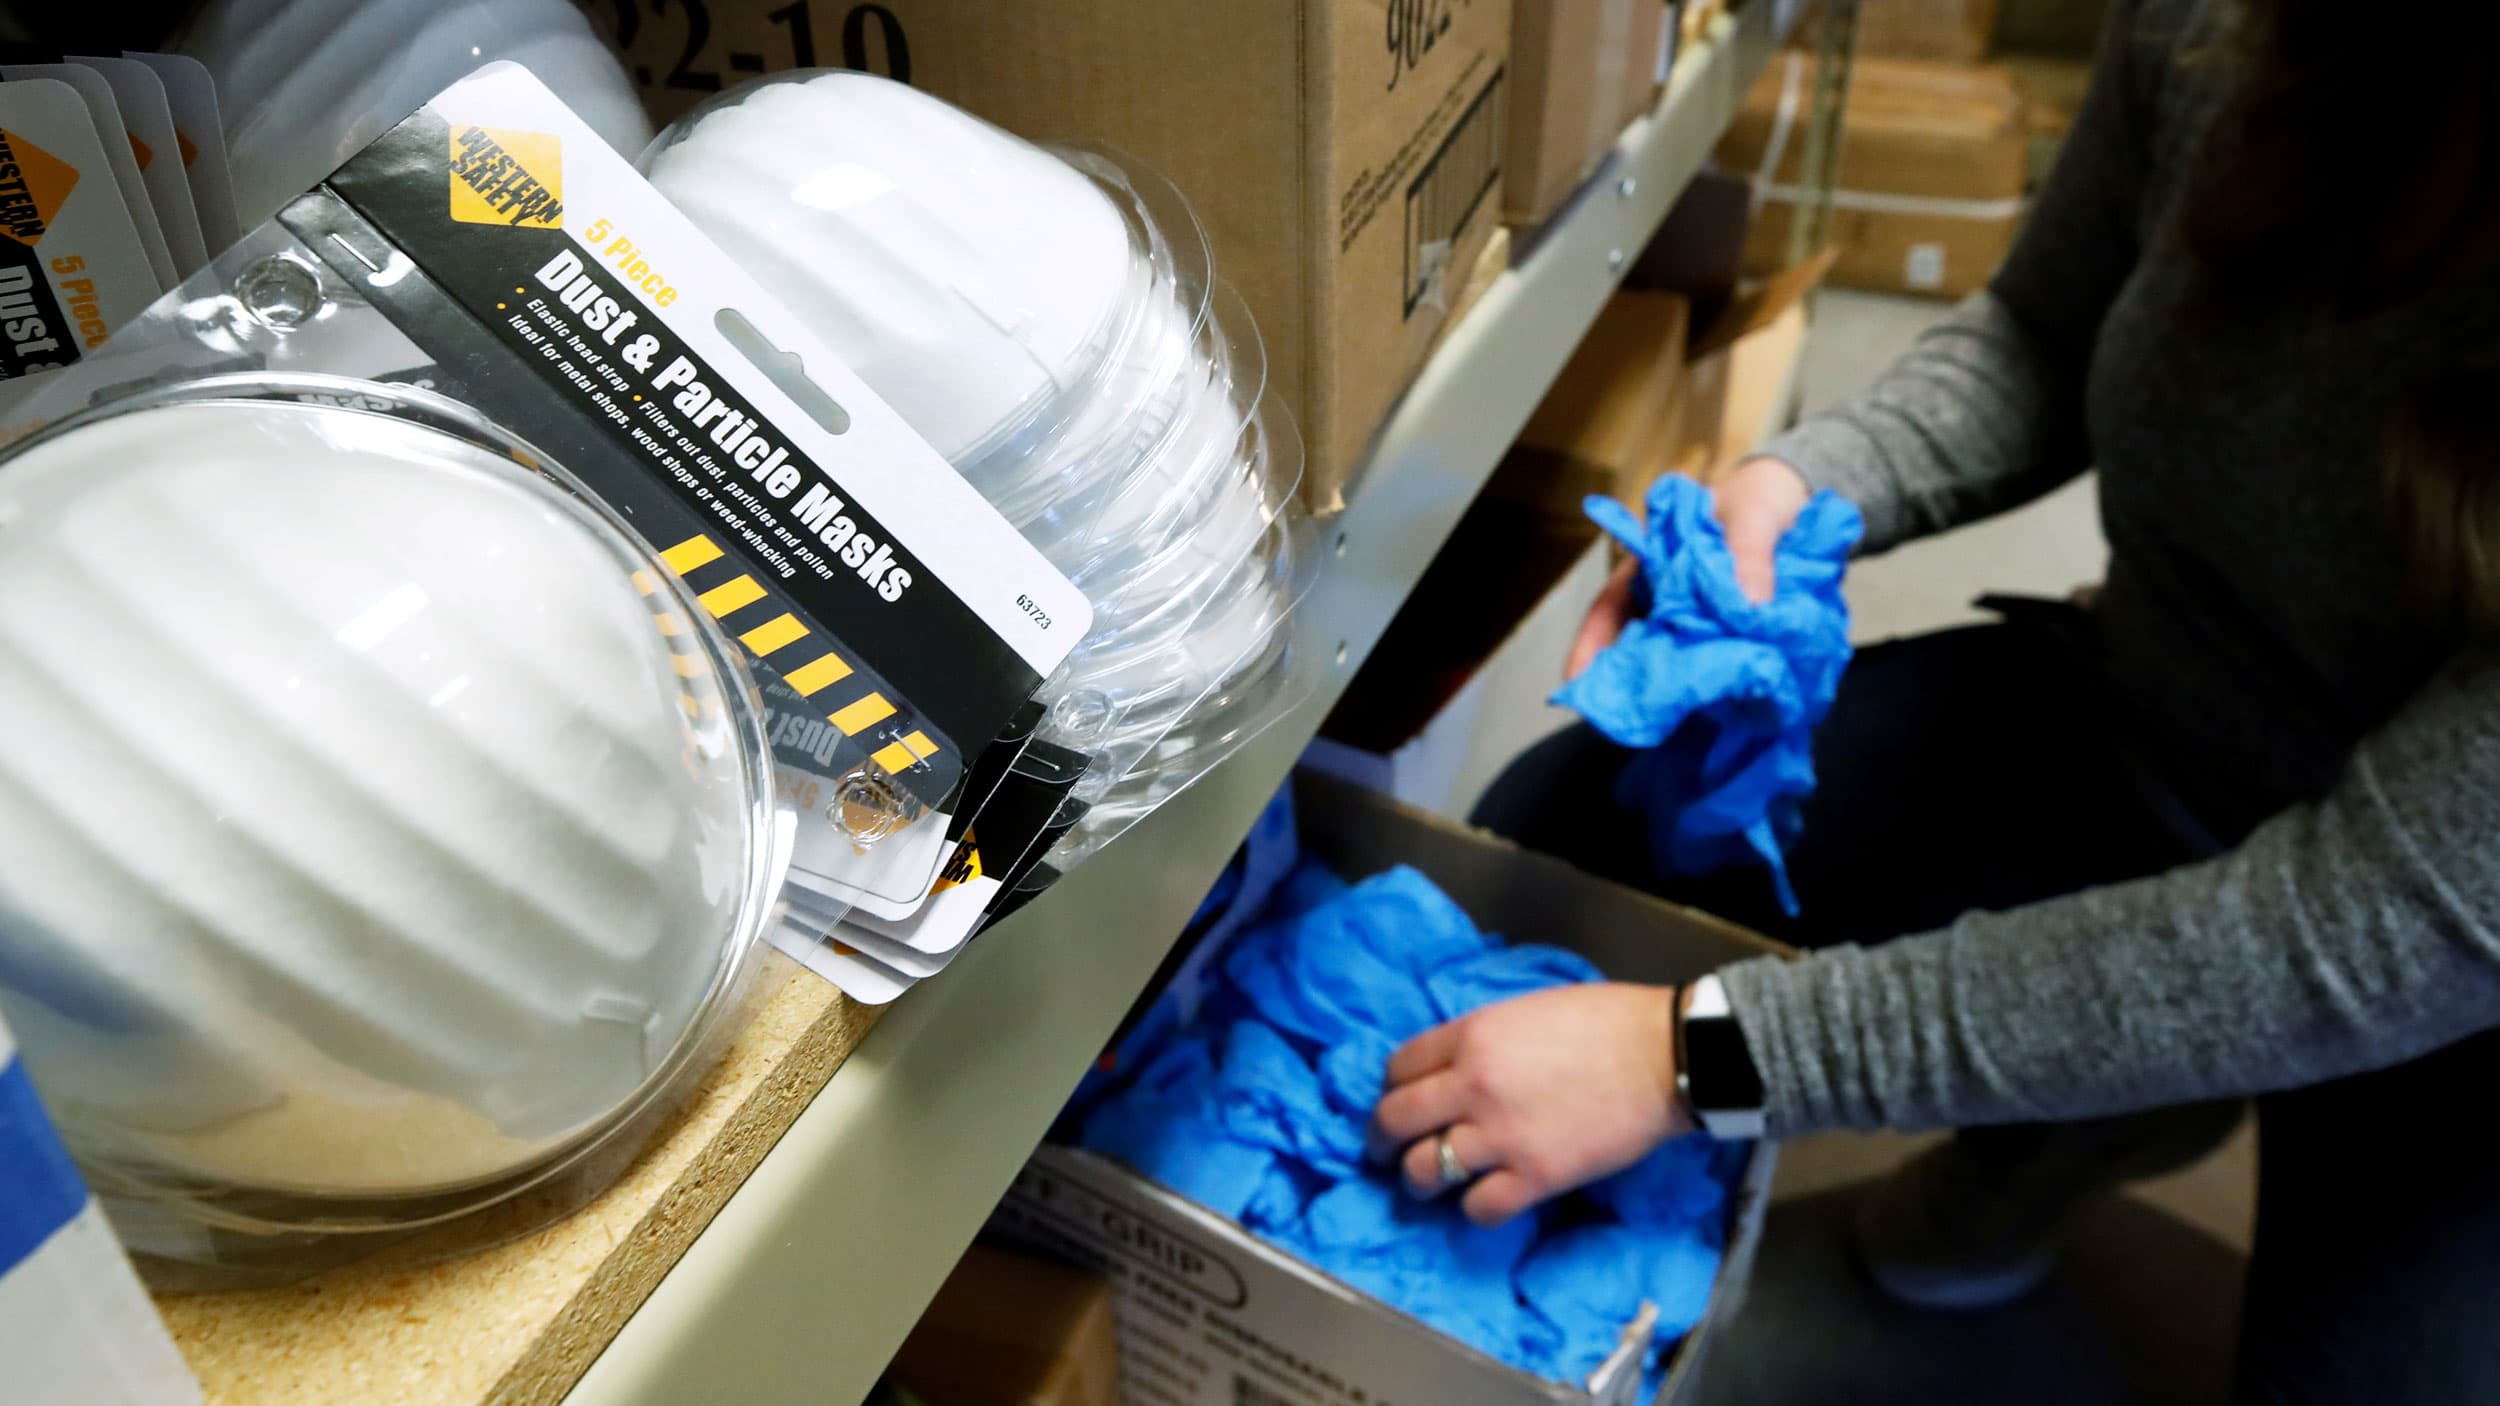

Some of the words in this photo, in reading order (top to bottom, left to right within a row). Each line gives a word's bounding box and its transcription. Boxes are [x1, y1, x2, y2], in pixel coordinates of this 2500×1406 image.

[450, 151, 542, 226] SAFETY
[457, 126, 563, 224] WESTERN
[51, 255, 86, 274] 5
[584, 218, 614, 244] 5
[603, 236, 678, 307] Piece
[508, 314, 546, 344] Ideal
[539, 343, 563, 361] for
[557, 361, 599, 393] metal
[591, 392, 630, 429] shops,
[631, 427, 668, 457] wood
[662, 456, 700, 489] shops
[696, 487, 714, 501] or
[710, 499, 797, 578] weed-whacking
[526, 299, 571, 337] Elastic
[566, 335, 603, 364] head
[596, 363, 630, 392] strap
[639, 401, 680, 438] Filters
[676, 437, 701, 457] out
[695, 455, 727, 483] dust,
[723, 481, 777, 527] particles
[774, 526, 802, 548] and
[793, 546, 834, 580] pollen
[534, 249, 638, 346] Dust
[622, 334, 660, 374] &
[651, 355, 802, 499] Particle
[790, 482, 912, 602] Masks
[1016, 593, 1052, 630] 63723
